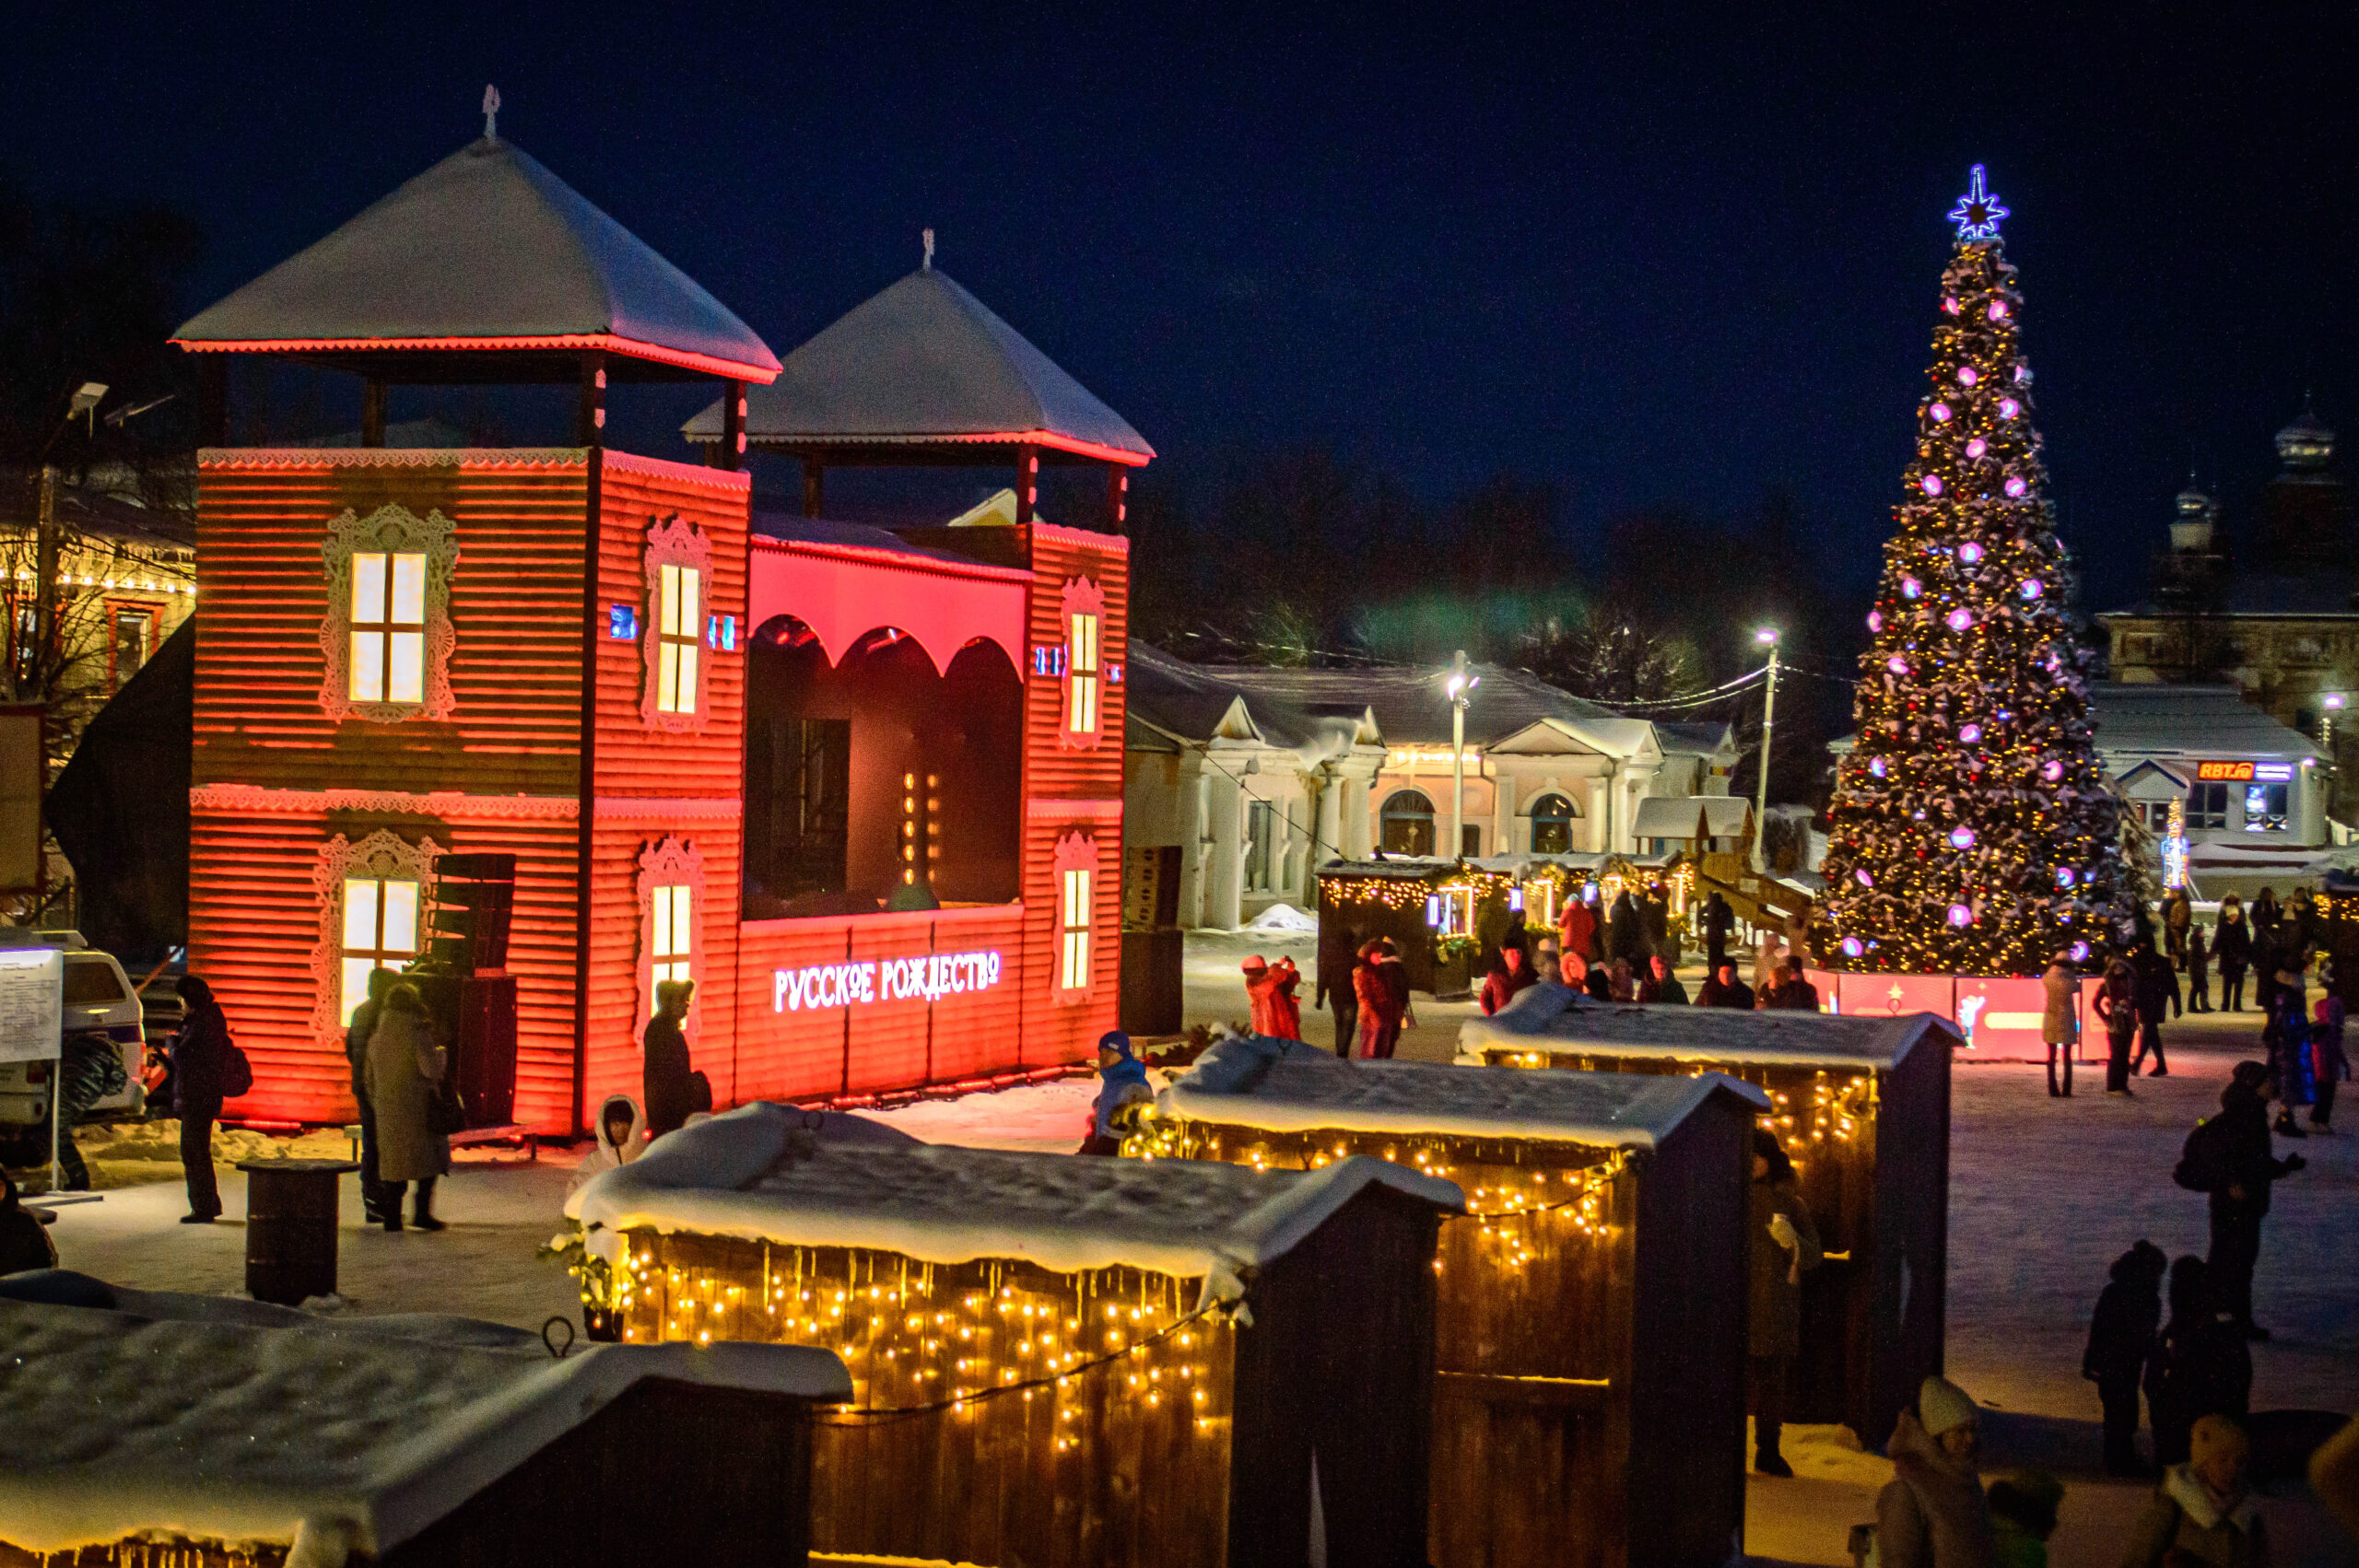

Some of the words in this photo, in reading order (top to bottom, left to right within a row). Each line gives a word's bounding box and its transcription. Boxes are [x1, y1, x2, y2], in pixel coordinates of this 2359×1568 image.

[2200, 763, 2253, 778] RBT.ru
[774, 962, 875, 1012] РУССКОЕ
[881, 951, 1001, 1000] РОЖДЕСТВО
